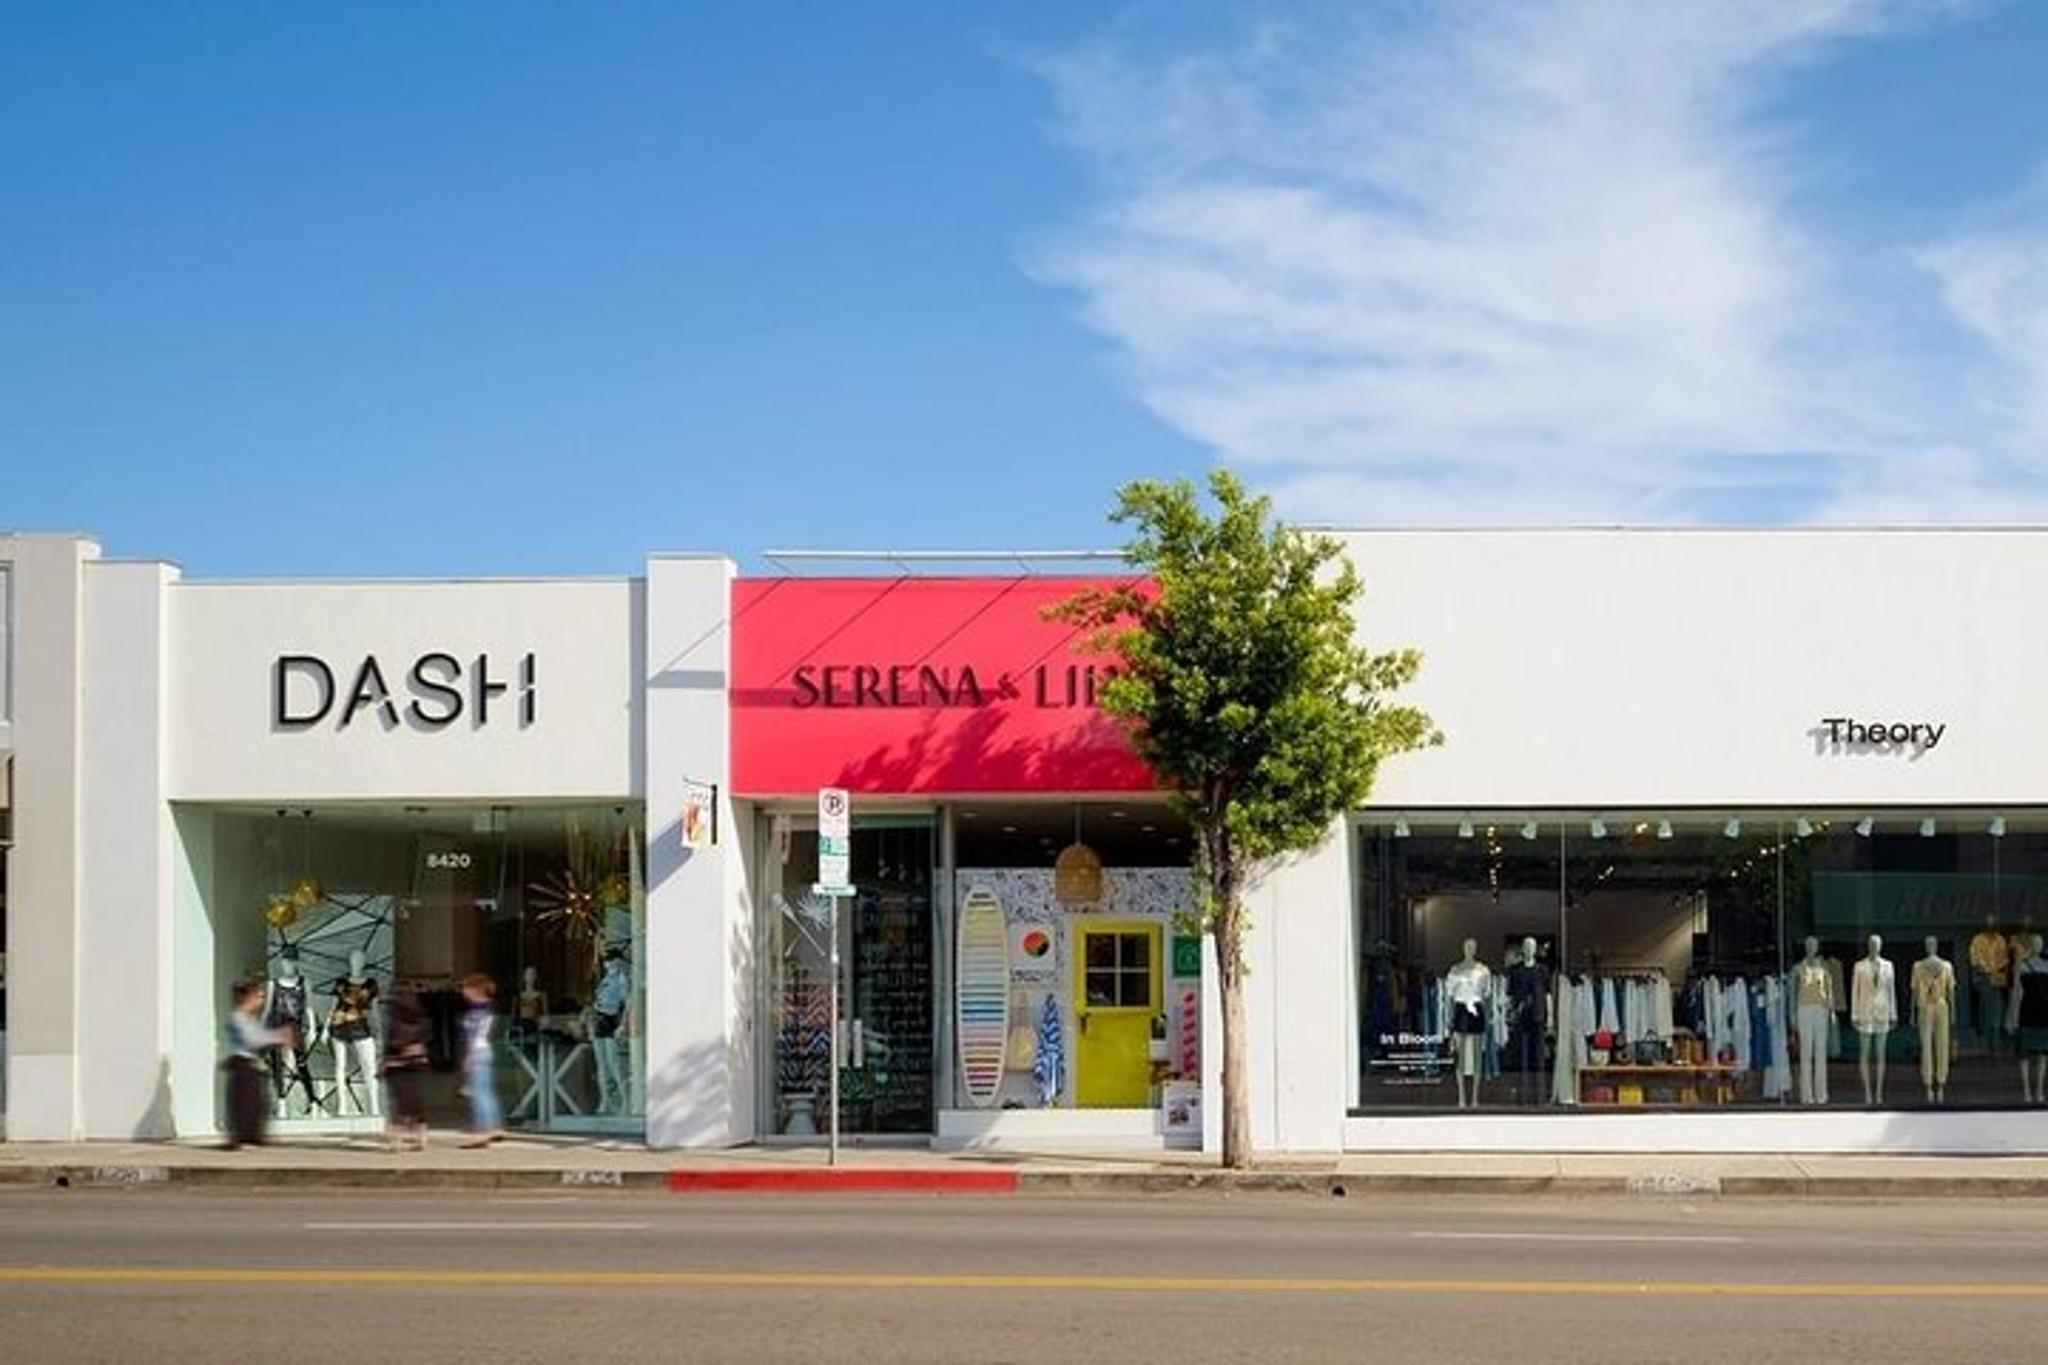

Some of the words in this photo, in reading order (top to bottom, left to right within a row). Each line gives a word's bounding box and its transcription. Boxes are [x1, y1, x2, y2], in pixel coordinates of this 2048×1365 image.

[278, 652, 535, 725] DASH
[792, 664, 984, 708] SERENA
[998, 672, 1021, 701] &
[1821, 718, 1946, 749] Theory
[426, 852, 471, 869] 8420
